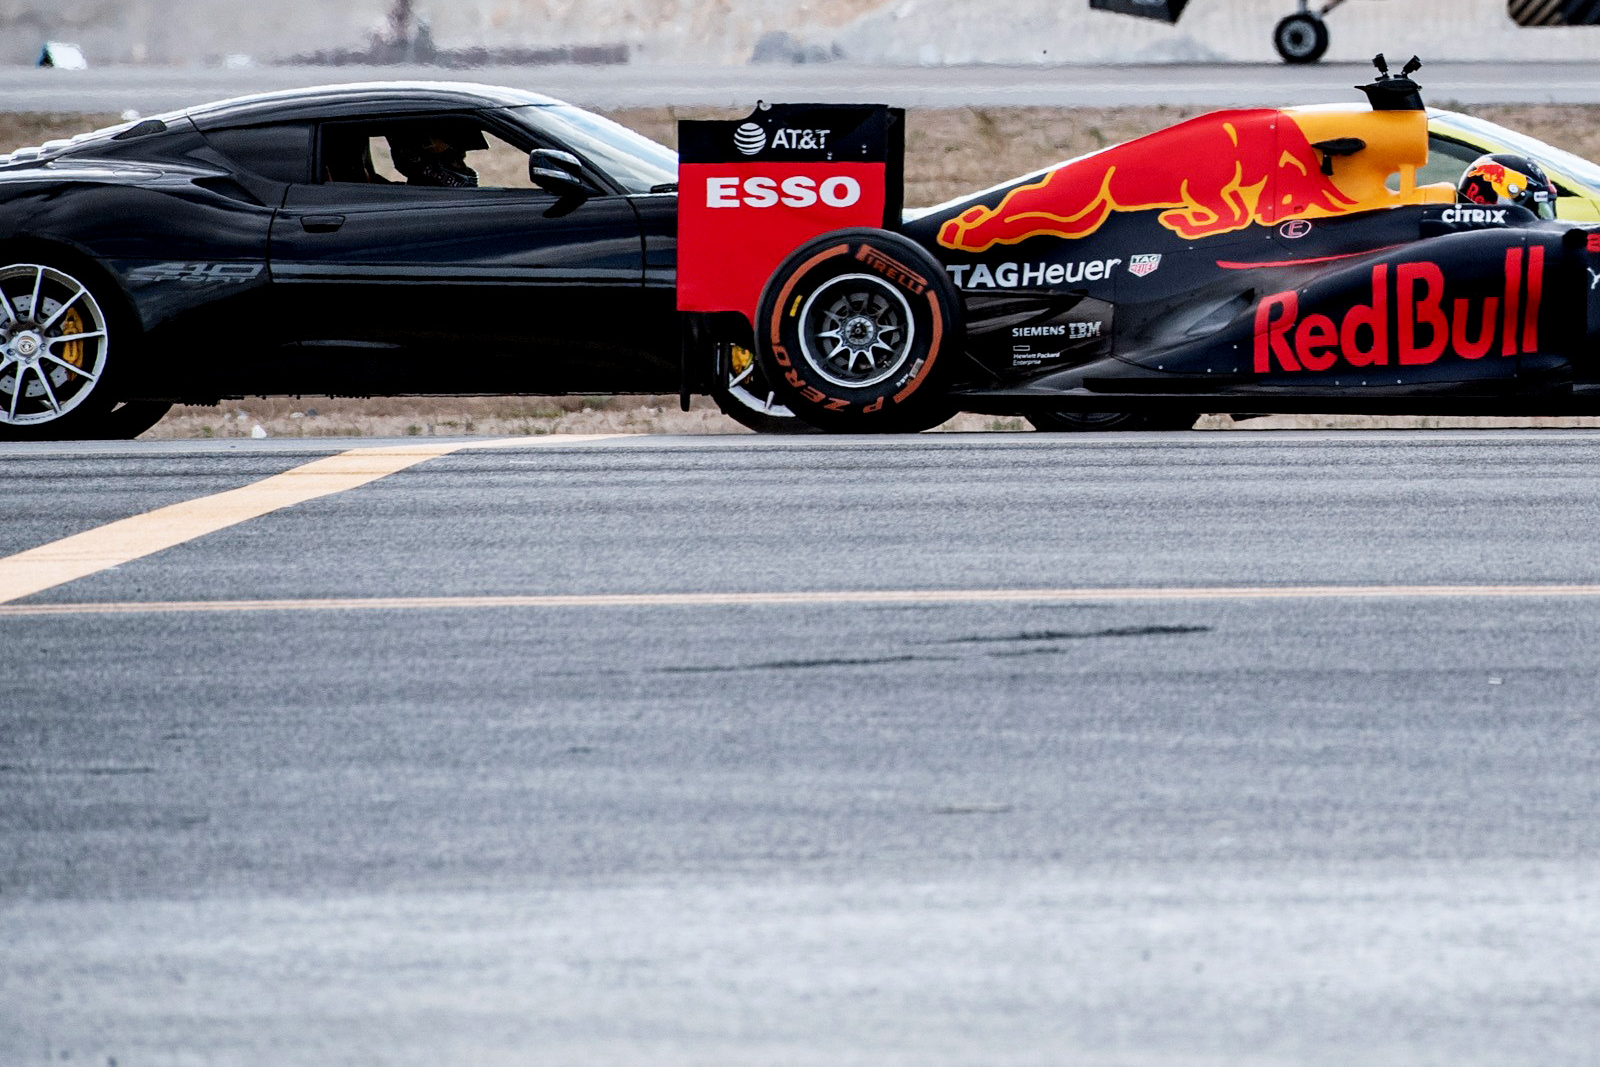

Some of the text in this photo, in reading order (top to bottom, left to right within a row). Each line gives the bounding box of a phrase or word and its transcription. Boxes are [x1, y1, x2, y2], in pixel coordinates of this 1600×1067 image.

[771, 128, 831, 149] AT&T
[706, 176, 861, 208] ESSO
[855, 244, 928, 295] PIRELLI
[1012, 321, 1102, 339] SIEMENS IBM
[1013, 359, 1042, 367] Enterprise
[1037, 351, 1060, 359] Packard
